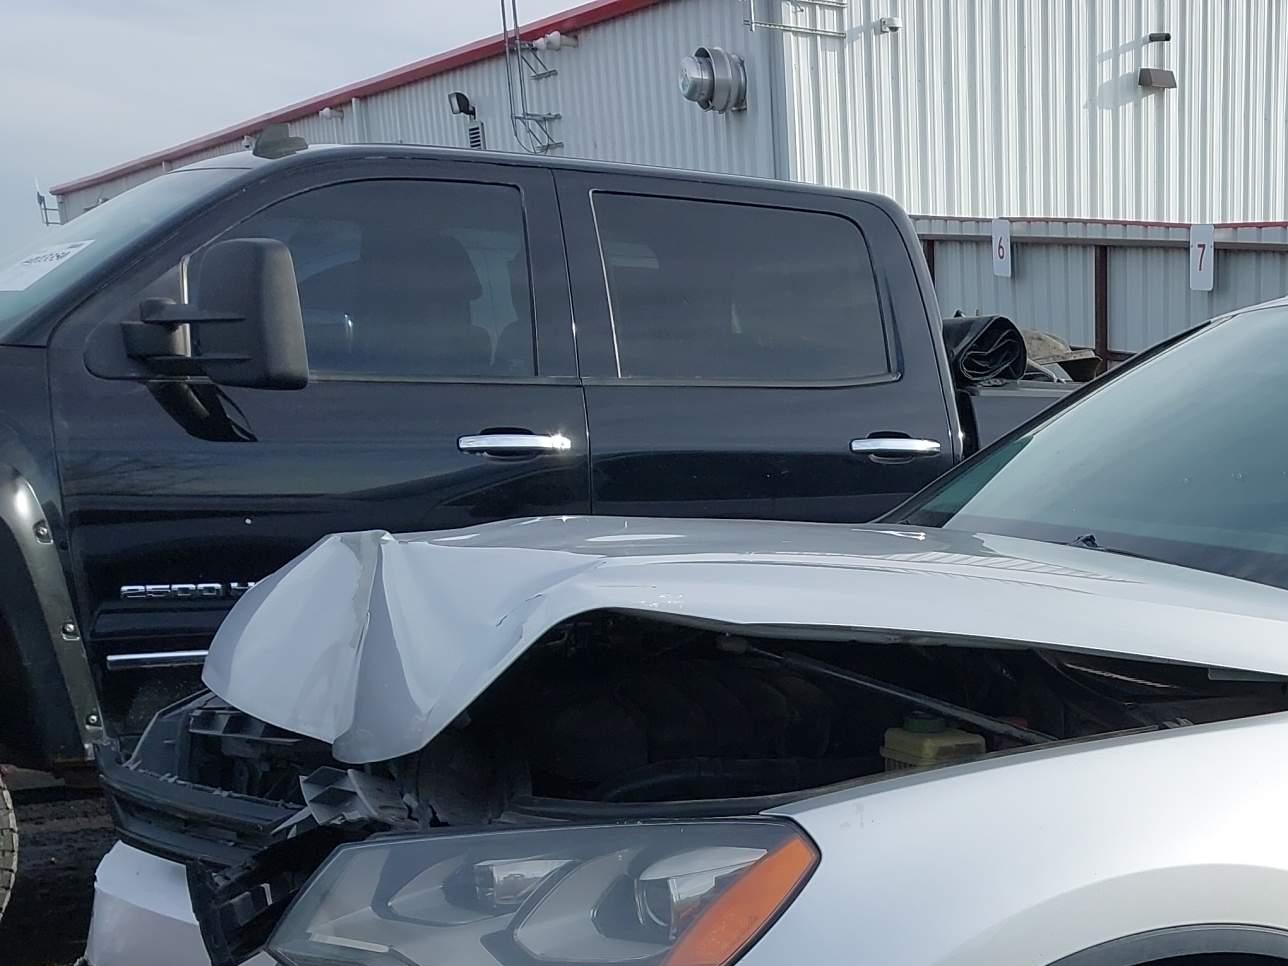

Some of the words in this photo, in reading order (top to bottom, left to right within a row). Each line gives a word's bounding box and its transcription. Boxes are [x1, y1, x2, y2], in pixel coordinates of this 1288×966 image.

[997, 236, 1005, 260] 6
[1197, 243, 1207, 272] 7
[120, 583, 225, 600] 2500
